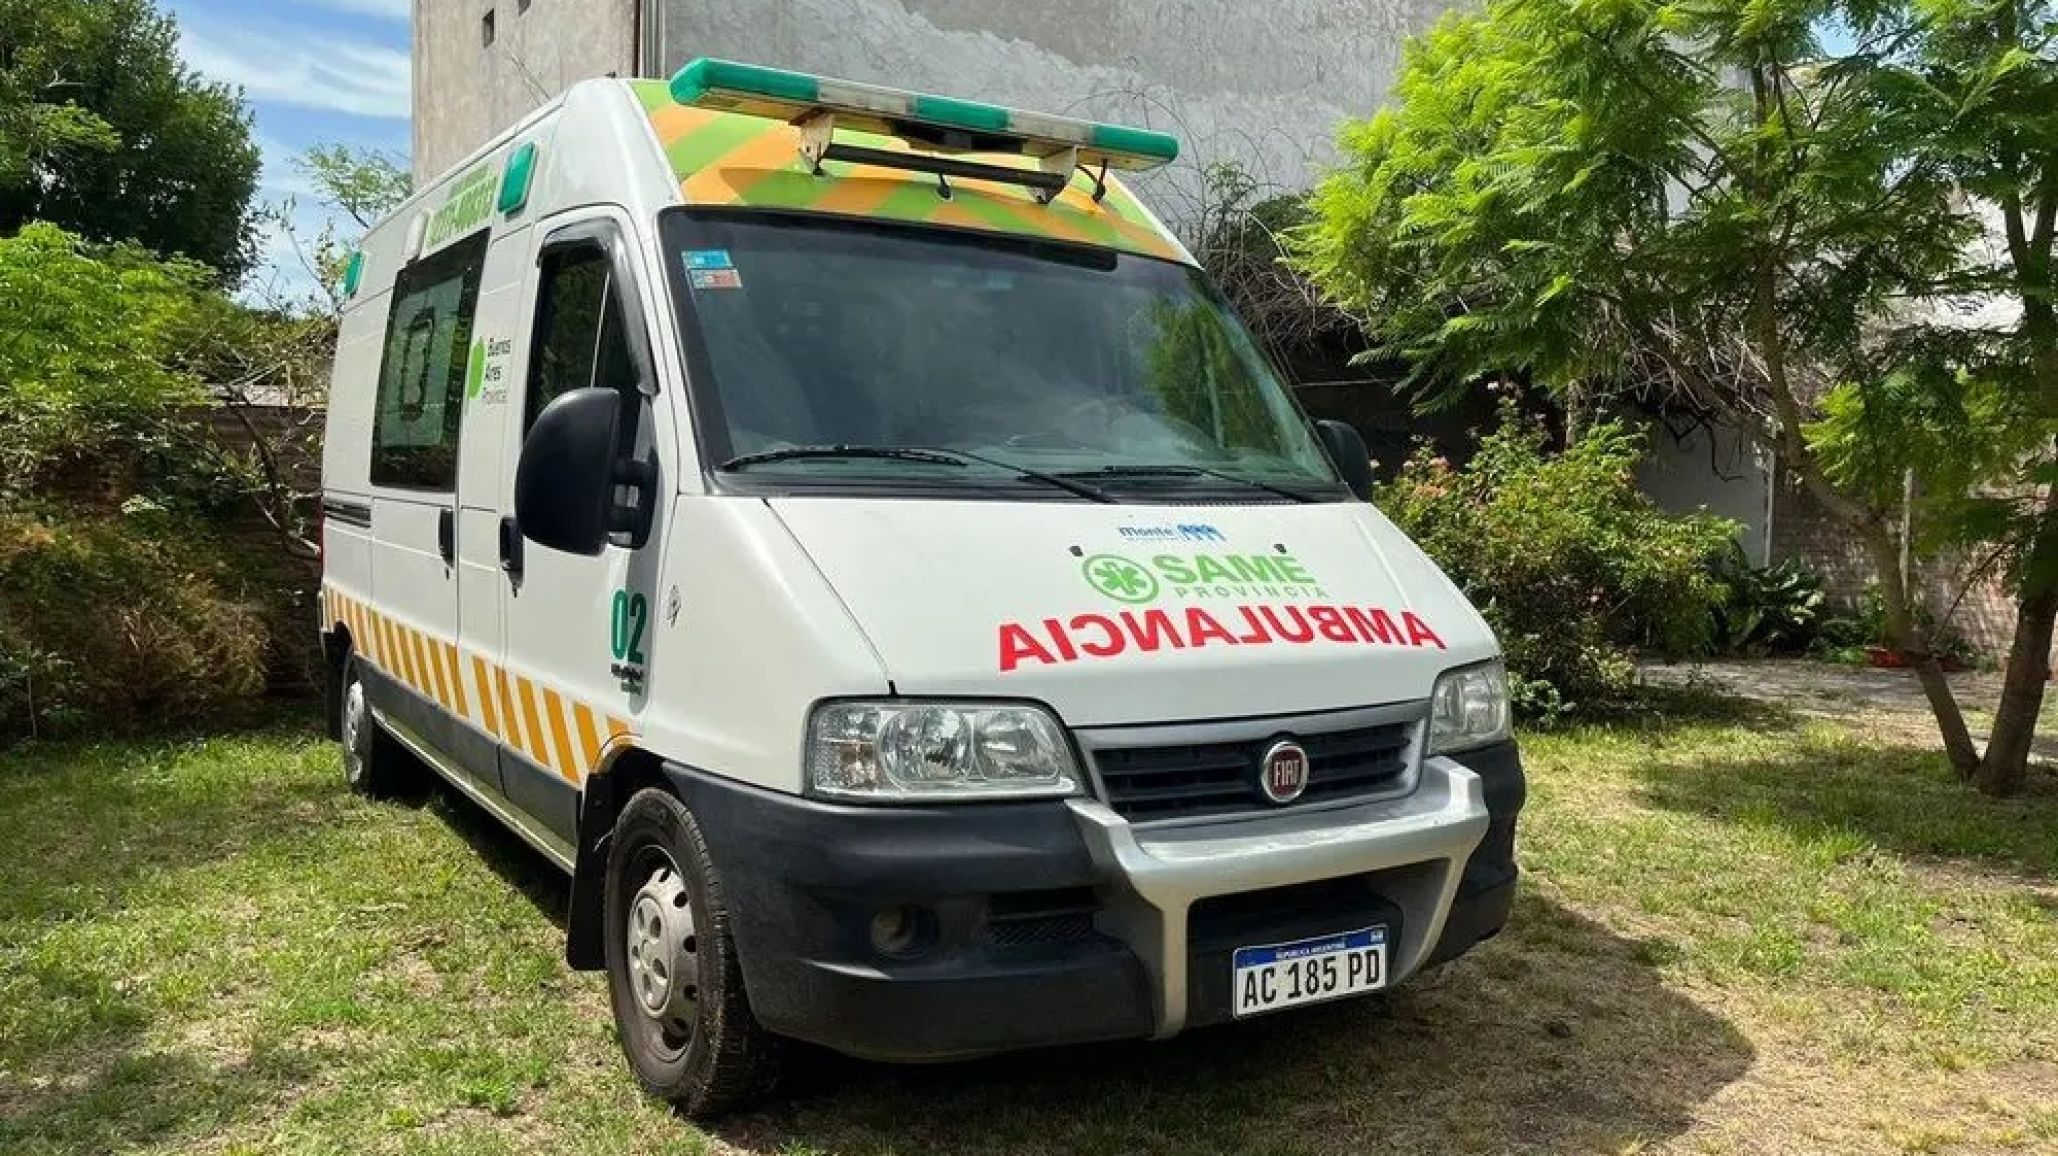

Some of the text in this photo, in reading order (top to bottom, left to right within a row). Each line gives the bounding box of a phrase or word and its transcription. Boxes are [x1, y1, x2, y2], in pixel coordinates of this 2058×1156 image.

[1152, 554, 1316, 584] SAME
[1174, 585, 1329, 598] PROVINCIA
[612, 590, 647, 664] 02
[1273, 759, 1300, 787] FIAT
[1243, 950, 1379, 1008] AC 185 PD
